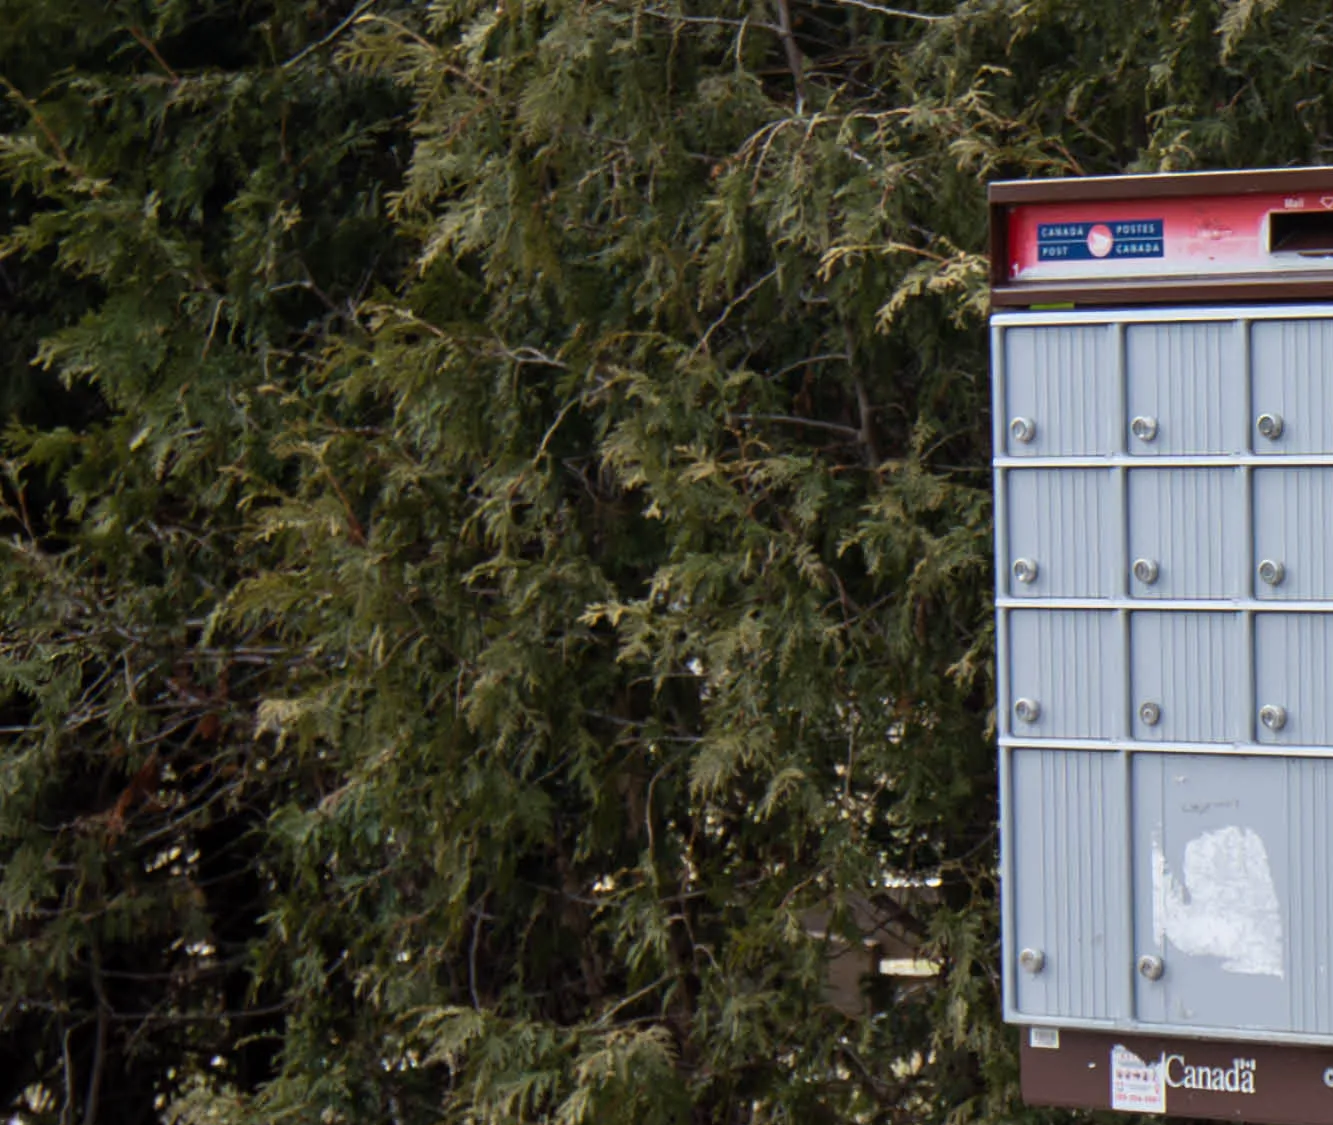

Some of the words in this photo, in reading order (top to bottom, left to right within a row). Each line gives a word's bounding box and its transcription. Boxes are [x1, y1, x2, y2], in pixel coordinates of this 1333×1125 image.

[1041, 226, 1084, 238] CANADA
[1116, 223, 1156, 235] POSTES
[1042, 245, 1069, 257] POST
[1116, 242, 1161, 254] CANADA
[1166, 1054, 1256, 1094] Canada
